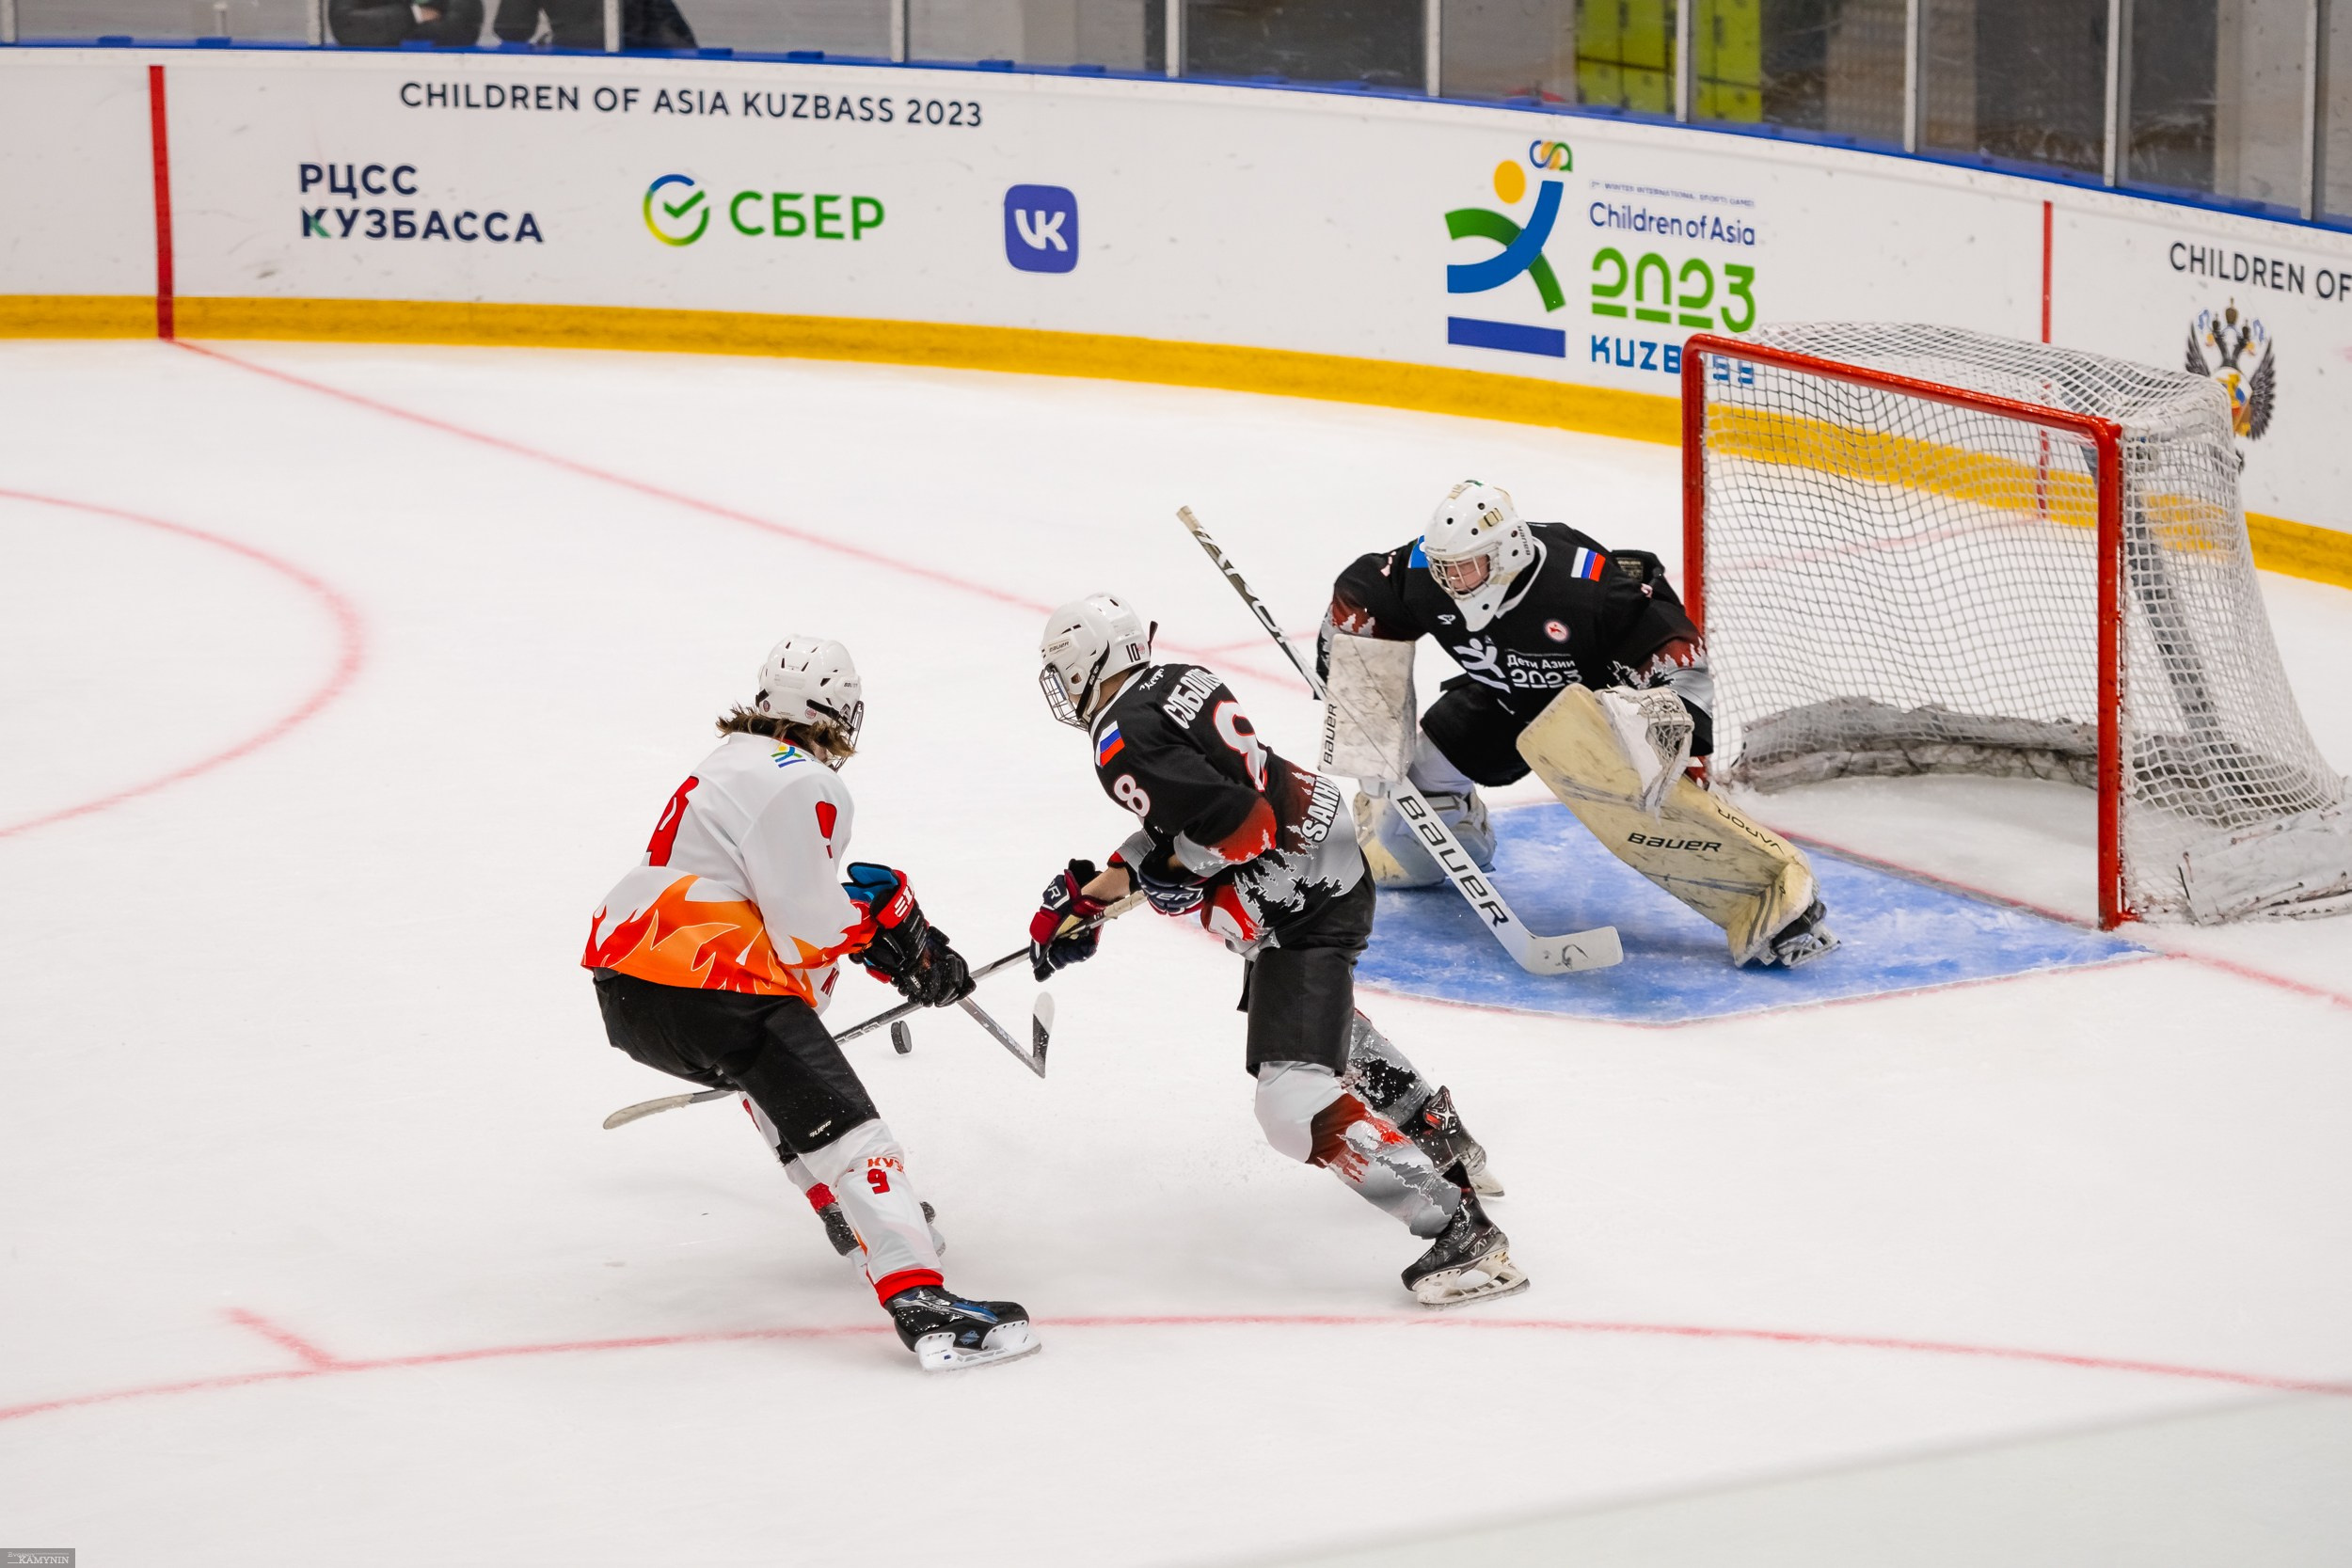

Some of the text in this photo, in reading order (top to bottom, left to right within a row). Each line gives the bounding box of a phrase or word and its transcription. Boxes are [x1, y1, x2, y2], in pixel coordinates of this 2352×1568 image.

[400, 82, 982, 127] CHILDREN OF ASIA KUZBASS 2023
[299, 163, 418, 199] РЦСС
[301, 208, 544, 243] КУЗБАССА
[729, 189, 885, 241] СБЕР
[1015, 208, 1069, 252] VK
[1589, 201, 1756, 246] Children of Asia
[1591, 246, 1756, 333] 2023
[2169, 241, 2352, 302] CHILDREN OF
[1591, 334, 1754, 385] KUZBSS
[1506, 654, 1576, 670] Дети Азии
[1510, 669, 1583, 689] 2023
[1323, 703, 1338, 766] BAUER
[1114, 774, 1151, 817] 8
[1396, 795, 1509, 927] BAUER
[1627, 832, 1723, 853] BAUER
[866, 1168, 891, 1195] 9
